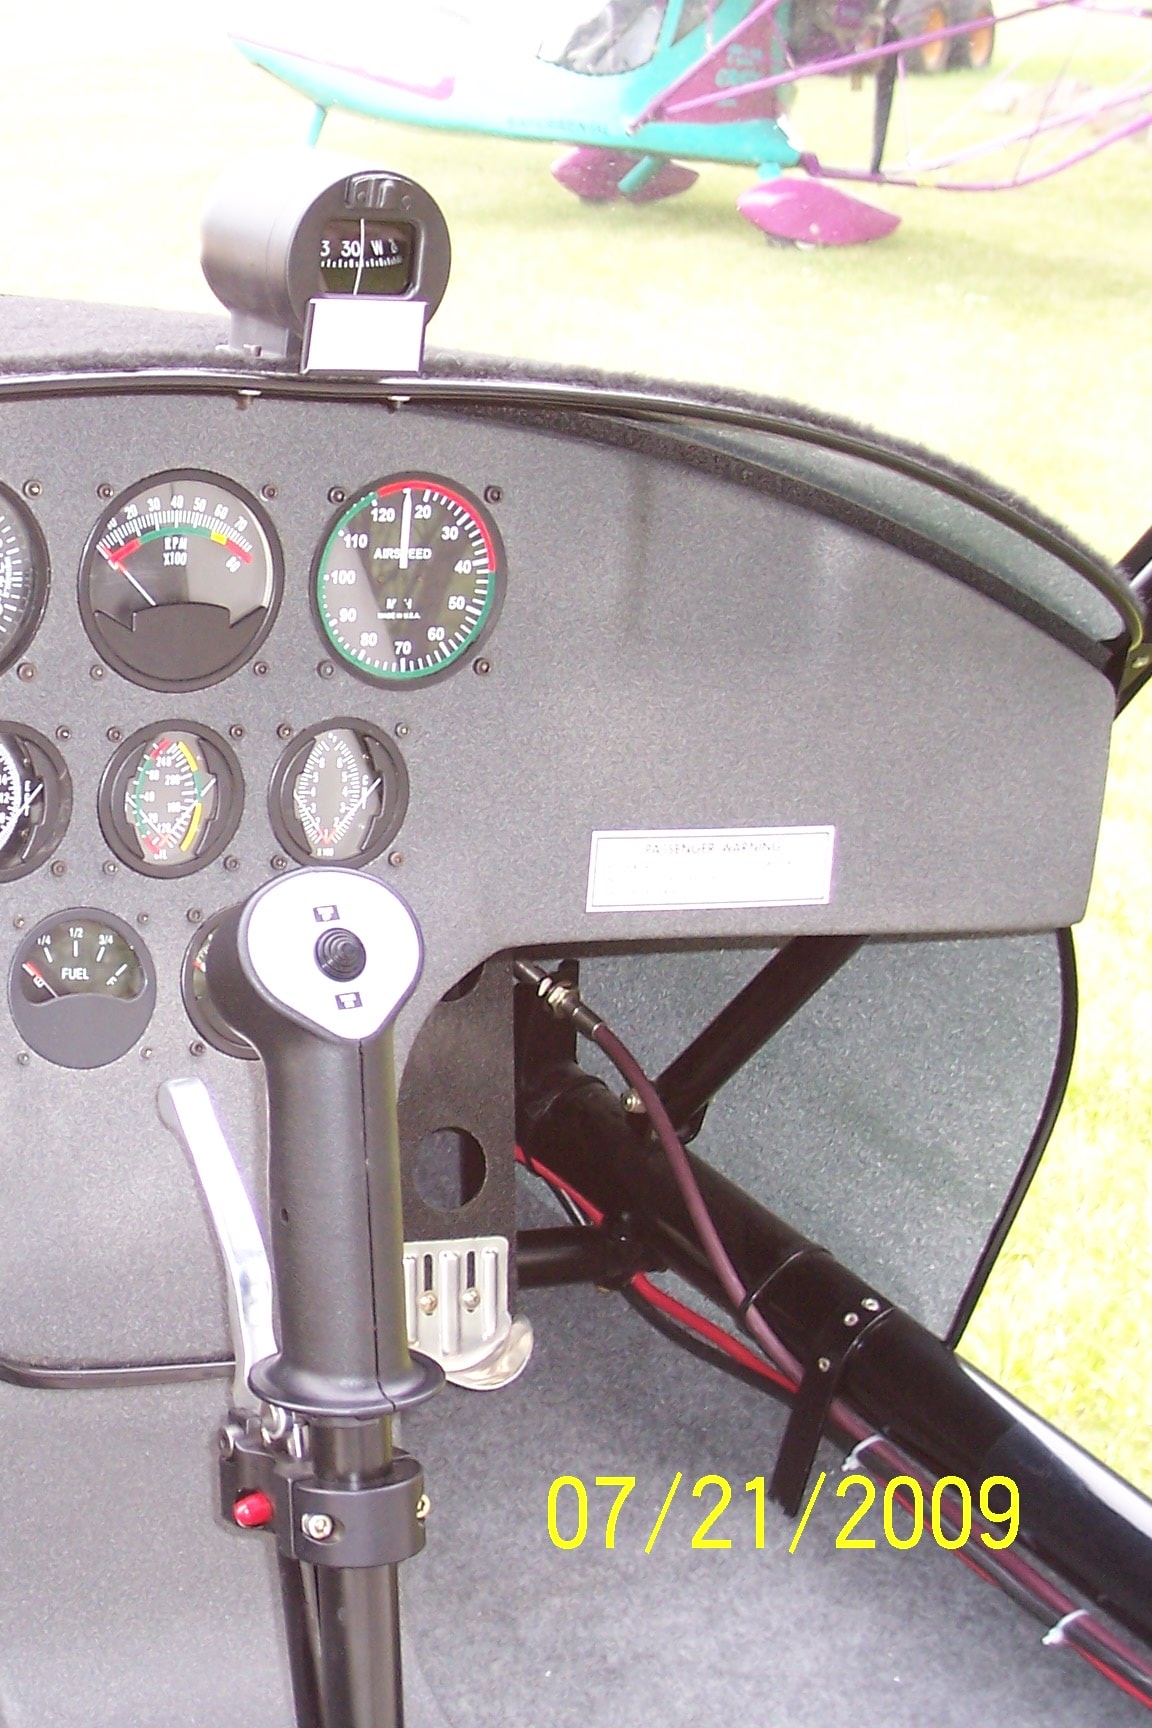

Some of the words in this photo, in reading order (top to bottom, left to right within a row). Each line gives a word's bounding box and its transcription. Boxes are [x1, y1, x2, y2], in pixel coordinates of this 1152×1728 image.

[341, 240, 361, 257] 30
[370, 239, 384, 256] W
[147, 497, 161, 511] 30
[170, 495, 184, 509] 40
[192, 497, 208, 512] 50
[124, 504, 139, 519] 20
[214, 504, 229, 520] 60
[370, 507, 396, 522] 120
[414, 504, 432, 519] 20
[234, 516, 248, 531] 70
[441, 526, 459, 540] 30
[164, 537, 188, 550] RPM
[343, 534, 368, 548] 110
[373, 548, 432, 560] AIRSEED
[454, 560, 472, 574] 40
[330, 570, 356, 584] 100
[448, 596, 465, 610] 50
[339, 608, 357, 622] 90
[360, 632, 378, 646] 80
[427, 627, 445, 641] 60
[394, 641, 412, 655] 70
[0, 792, 10, 804] 12
[645, 842, 715, 855] PASENGER
[69, 927, 83, 939] 1/2
[37, 935, 52, 946] 1/4
[98, 935, 114, 946] 3/4
[61, 967, 89, 980] FUEL
[106, 975, 118, 986] F
